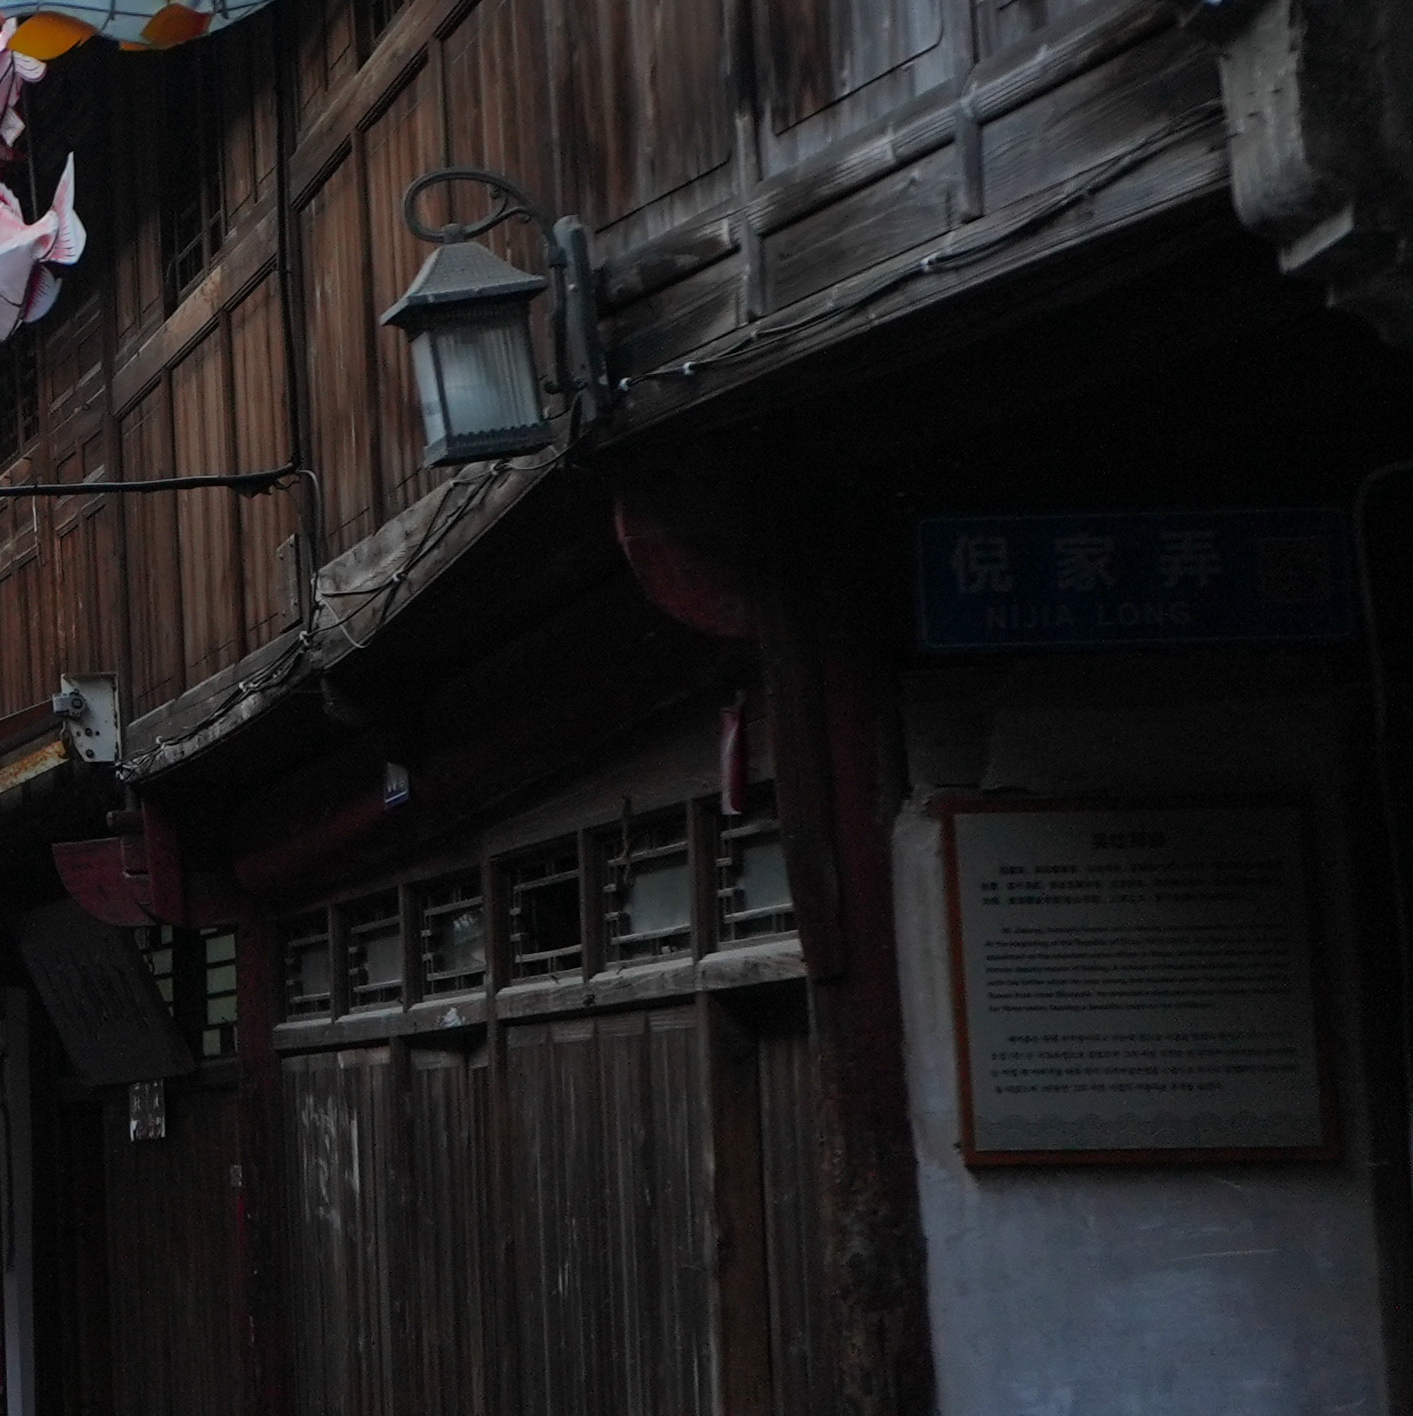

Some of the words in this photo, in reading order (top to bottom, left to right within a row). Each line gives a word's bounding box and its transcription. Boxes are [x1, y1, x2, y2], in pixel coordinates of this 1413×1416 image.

[950, 530, 1222, 595] 倪家弄
[985, 604, 1075, 631] NIJIA
[1096, 601, 1192, 627] LONG
